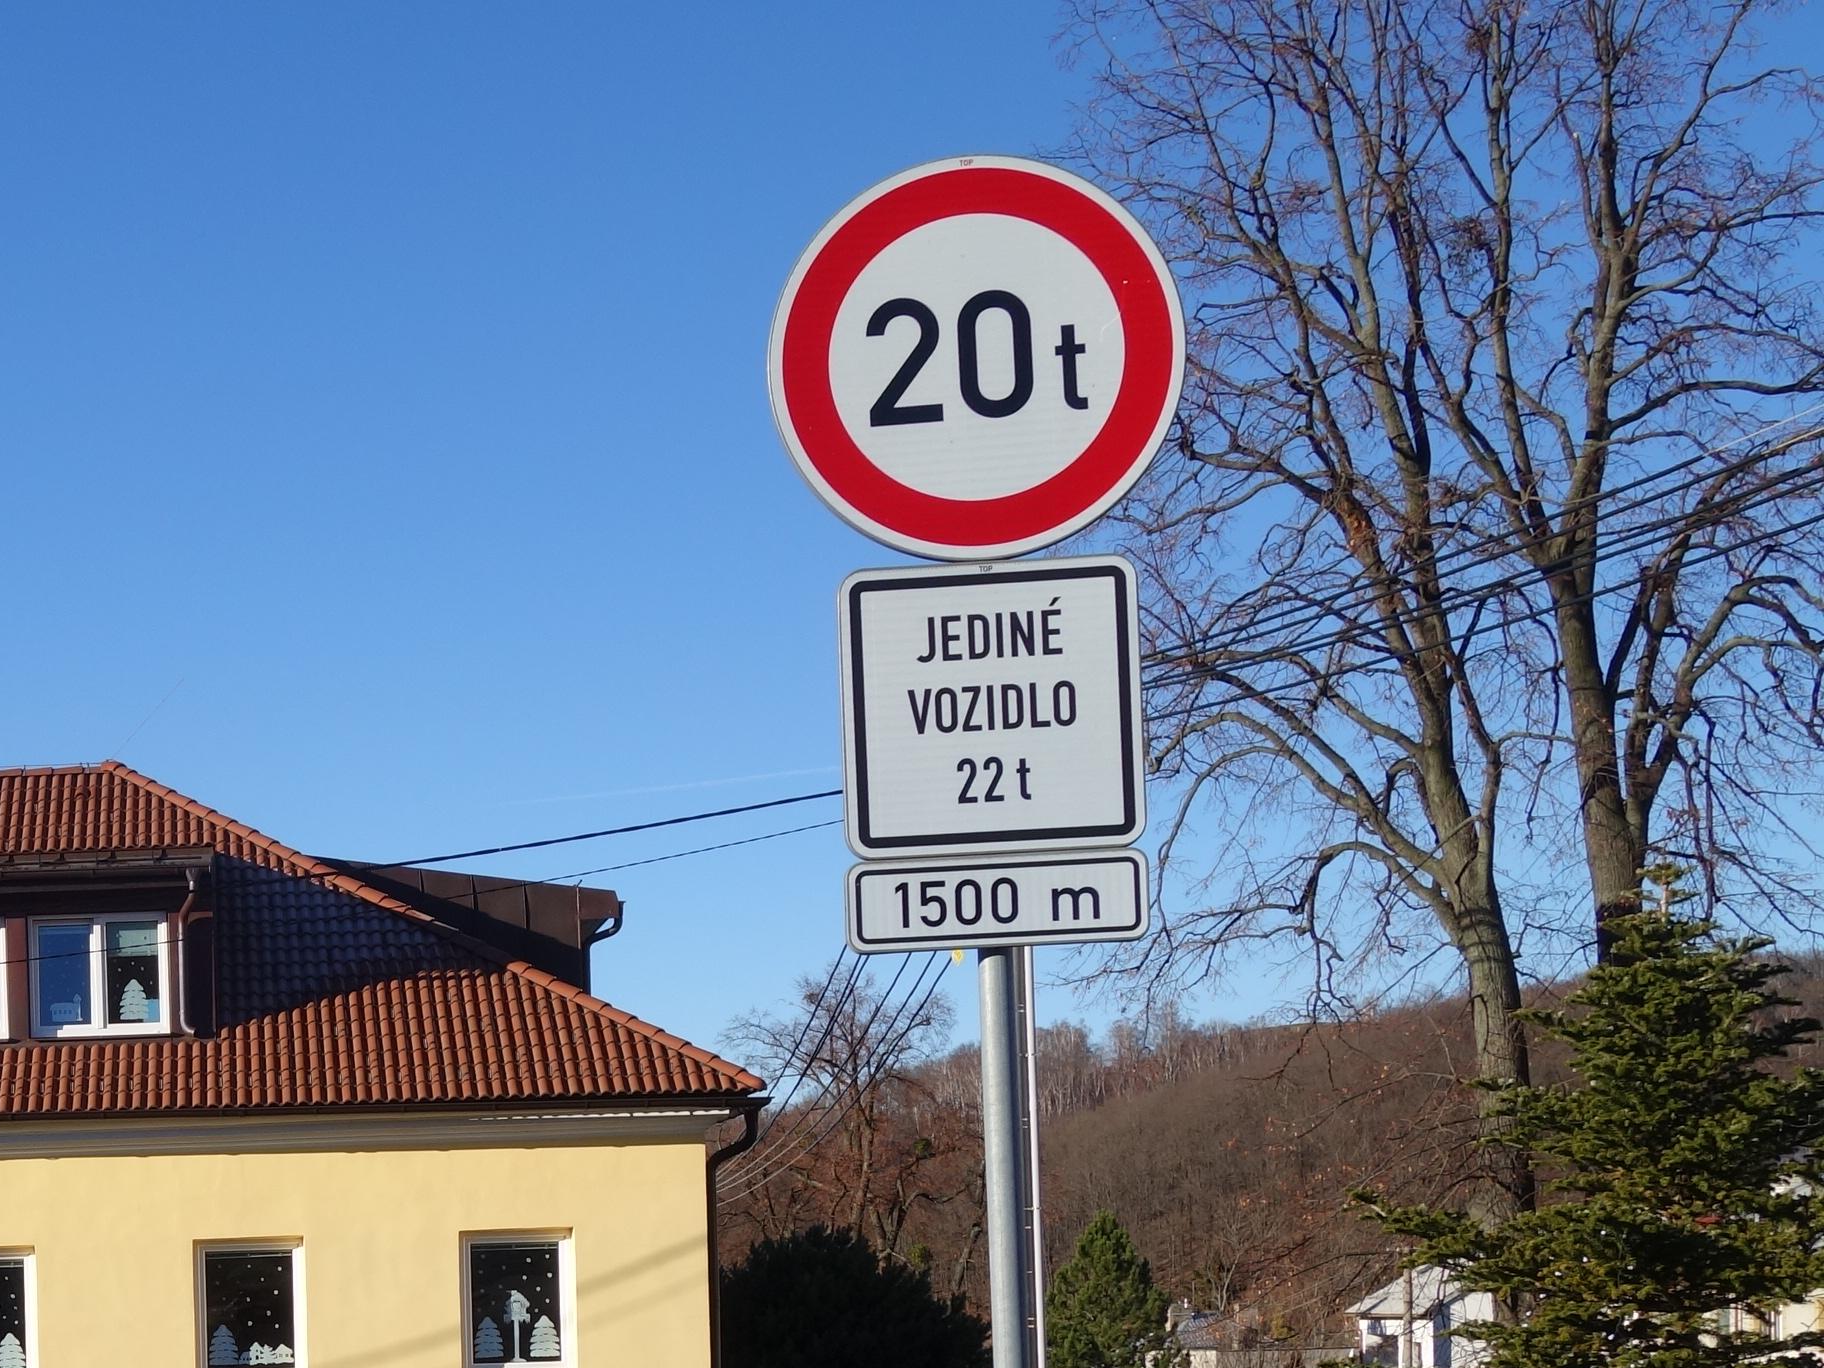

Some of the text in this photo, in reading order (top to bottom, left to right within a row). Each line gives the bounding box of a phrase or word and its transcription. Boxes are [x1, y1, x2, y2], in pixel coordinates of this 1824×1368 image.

[959, 159, 974, 167] TOP
[866, 290, 1090, 427] 20 t
[978, 564, 993, 573] TOP
[916, 597, 1064, 663] JEDINÉ
[907, 680, 1077, 735] VOZIDLO
[956, 757, 1033, 805] 22 t
[893, 877, 1102, 929] 1500 m
